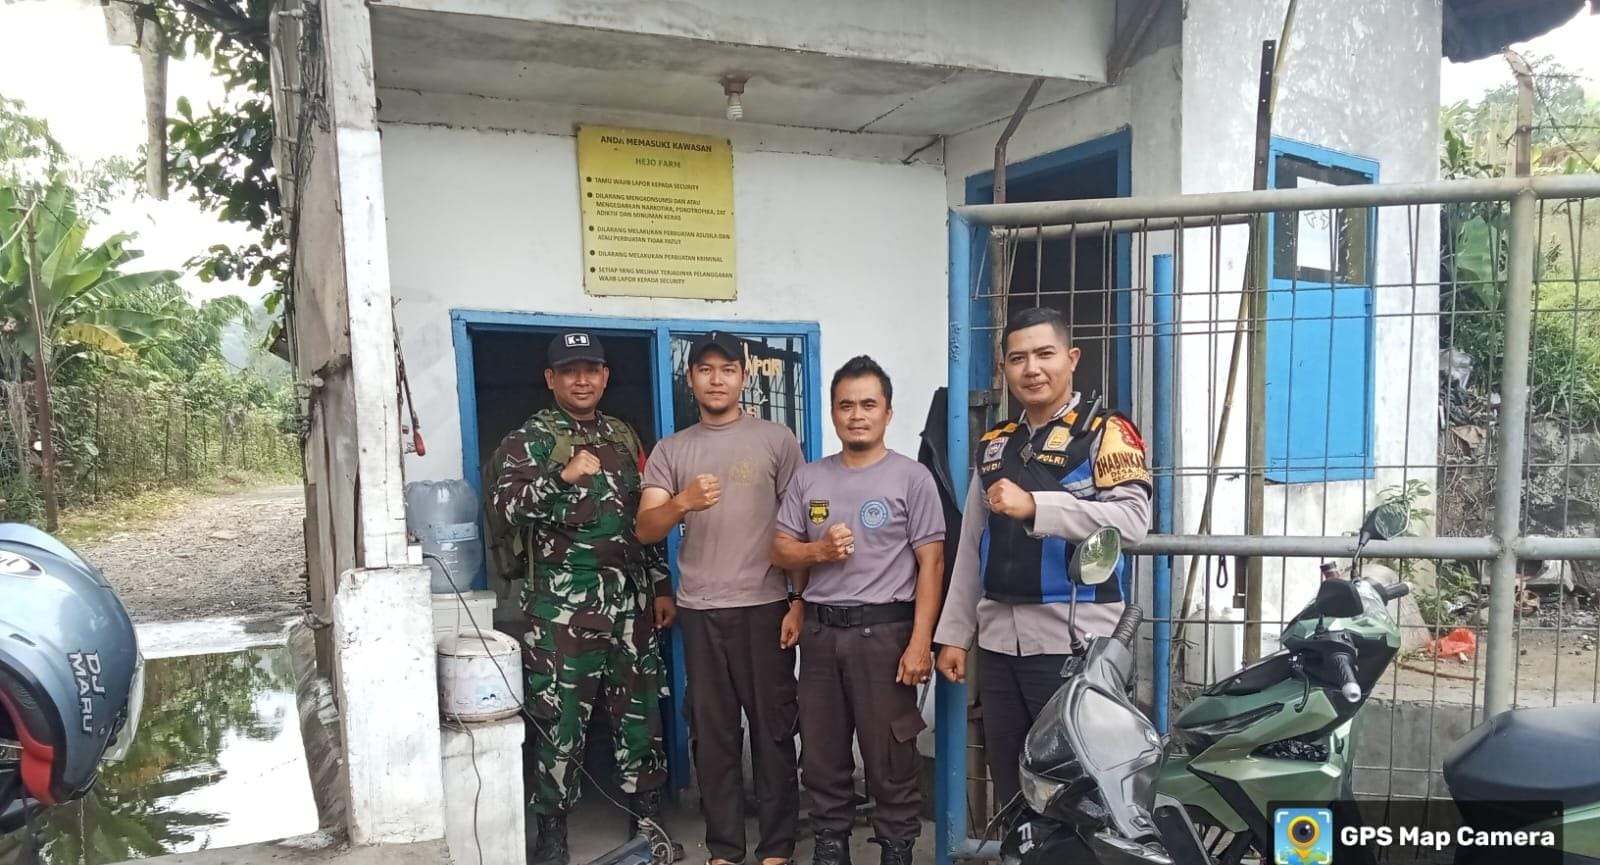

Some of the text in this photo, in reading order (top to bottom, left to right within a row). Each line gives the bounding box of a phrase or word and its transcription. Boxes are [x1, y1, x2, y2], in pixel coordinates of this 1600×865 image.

[626, 138, 671, 149] MEMASUKI
[672, 142, 712, 152] KAWASAN
[635, 157, 681, 168] HEJO FARM
[595, 193, 625, 201] DILARANG
[626, 195, 673, 203] MENGKONSUMSI
[596, 201, 640, 210] MENGEDARKAN
[642, 205, 674, 213] NARKOTIKA,
[633, 212, 663, 220] MINUMAN
[597, 226, 626, 234] DILARANG
[628, 228, 662, 236] MELAKUKAN
[614, 235, 646, 243] PERBUATAN
[628, 252, 663, 260] MELAKUKAN
[693, 271, 733, 279] PELANGGARAN
[1038, 454, 1064, 465] POLRI
[84, 651, 105, 698] DJ
[68, 651, 93, 734] MARU
